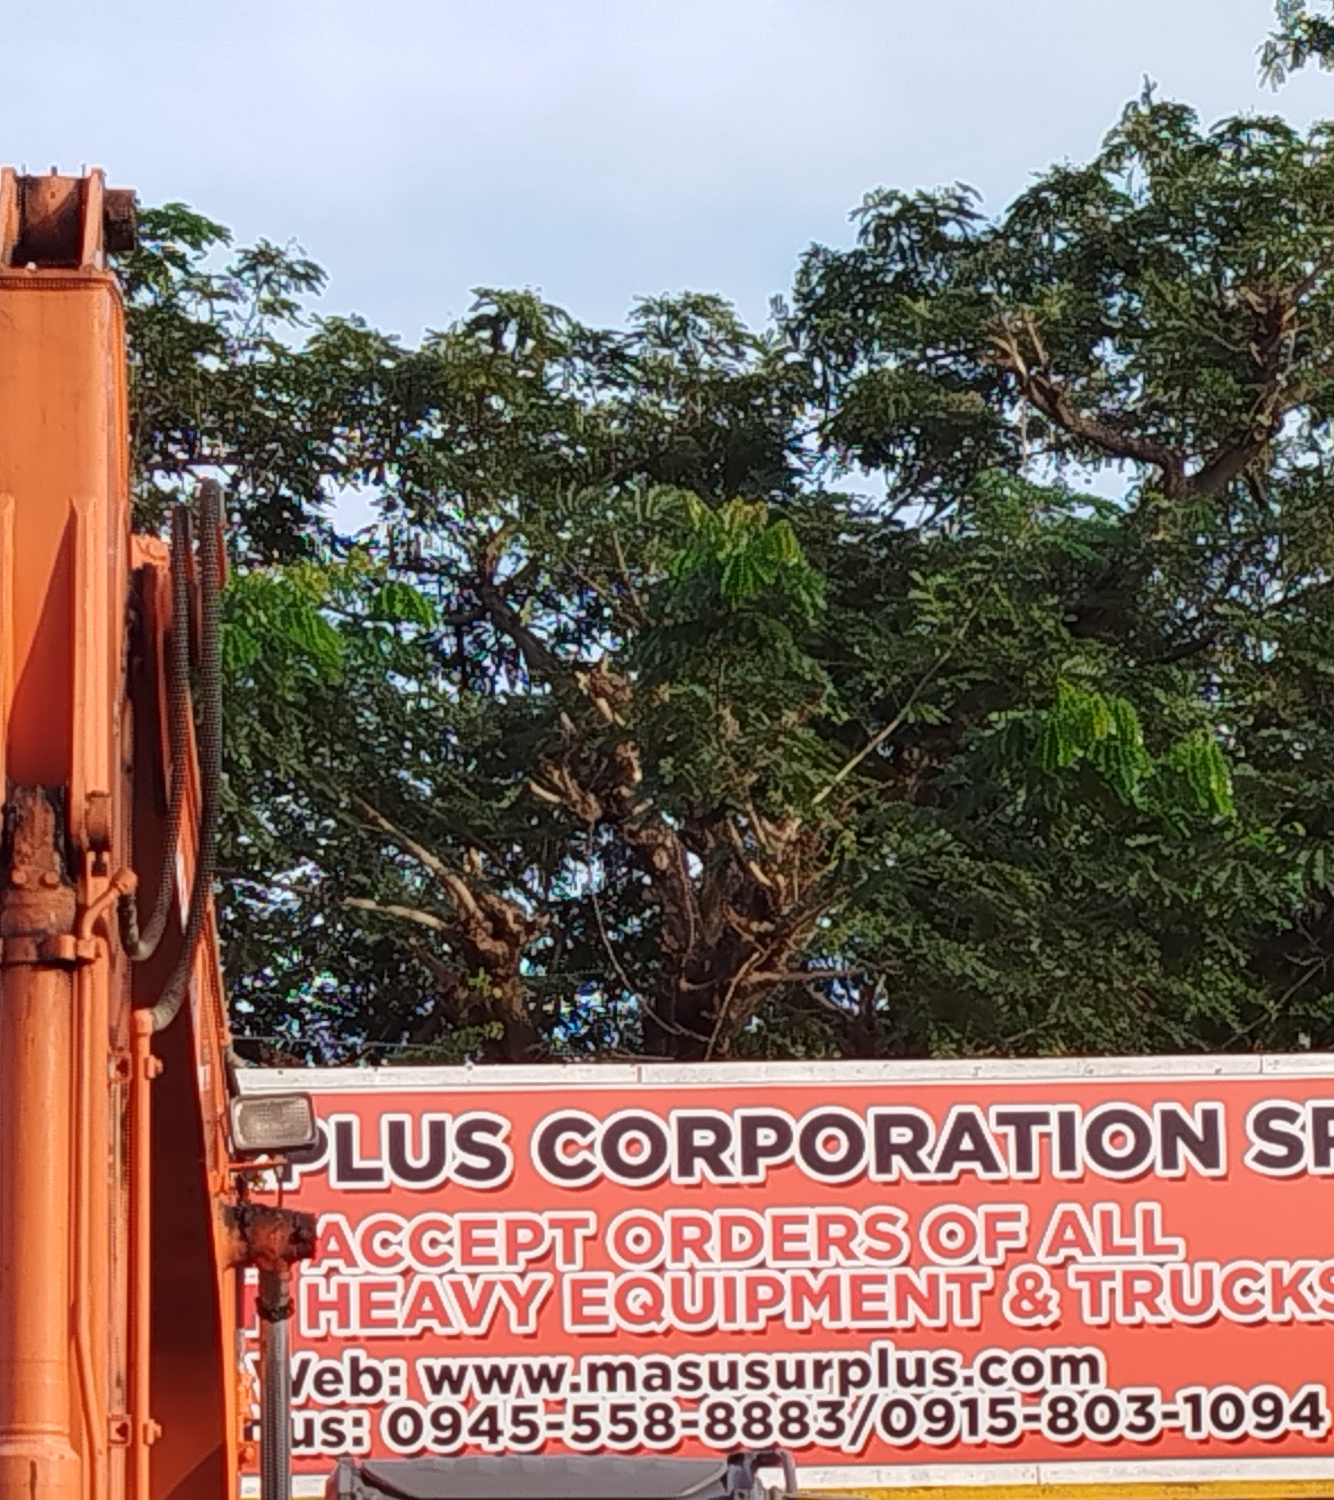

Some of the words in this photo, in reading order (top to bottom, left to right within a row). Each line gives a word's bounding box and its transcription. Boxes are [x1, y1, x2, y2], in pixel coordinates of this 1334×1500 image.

[265, 1111, 513, 1190] PLUS
[531, 1101, 1228, 1187] CORPORATION
[301, 1211, 597, 1273] ACCEPT
[608, 1205, 911, 1270] ORDERS
[919, 1203, 1029, 1266] OF
[1037, 1201, 1186, 1264] ALL
[298, 1272, 554, 1338] HEAVY
[564, 1266, 994, 1334] EQUIPMENT
[1002, 1265, 1062, 1327] &
[417, 1341, 1106, 1401] www.masusurplus.com
[381, 1386, 1331, 1452] 0945-558-8883/0915-803-1094
